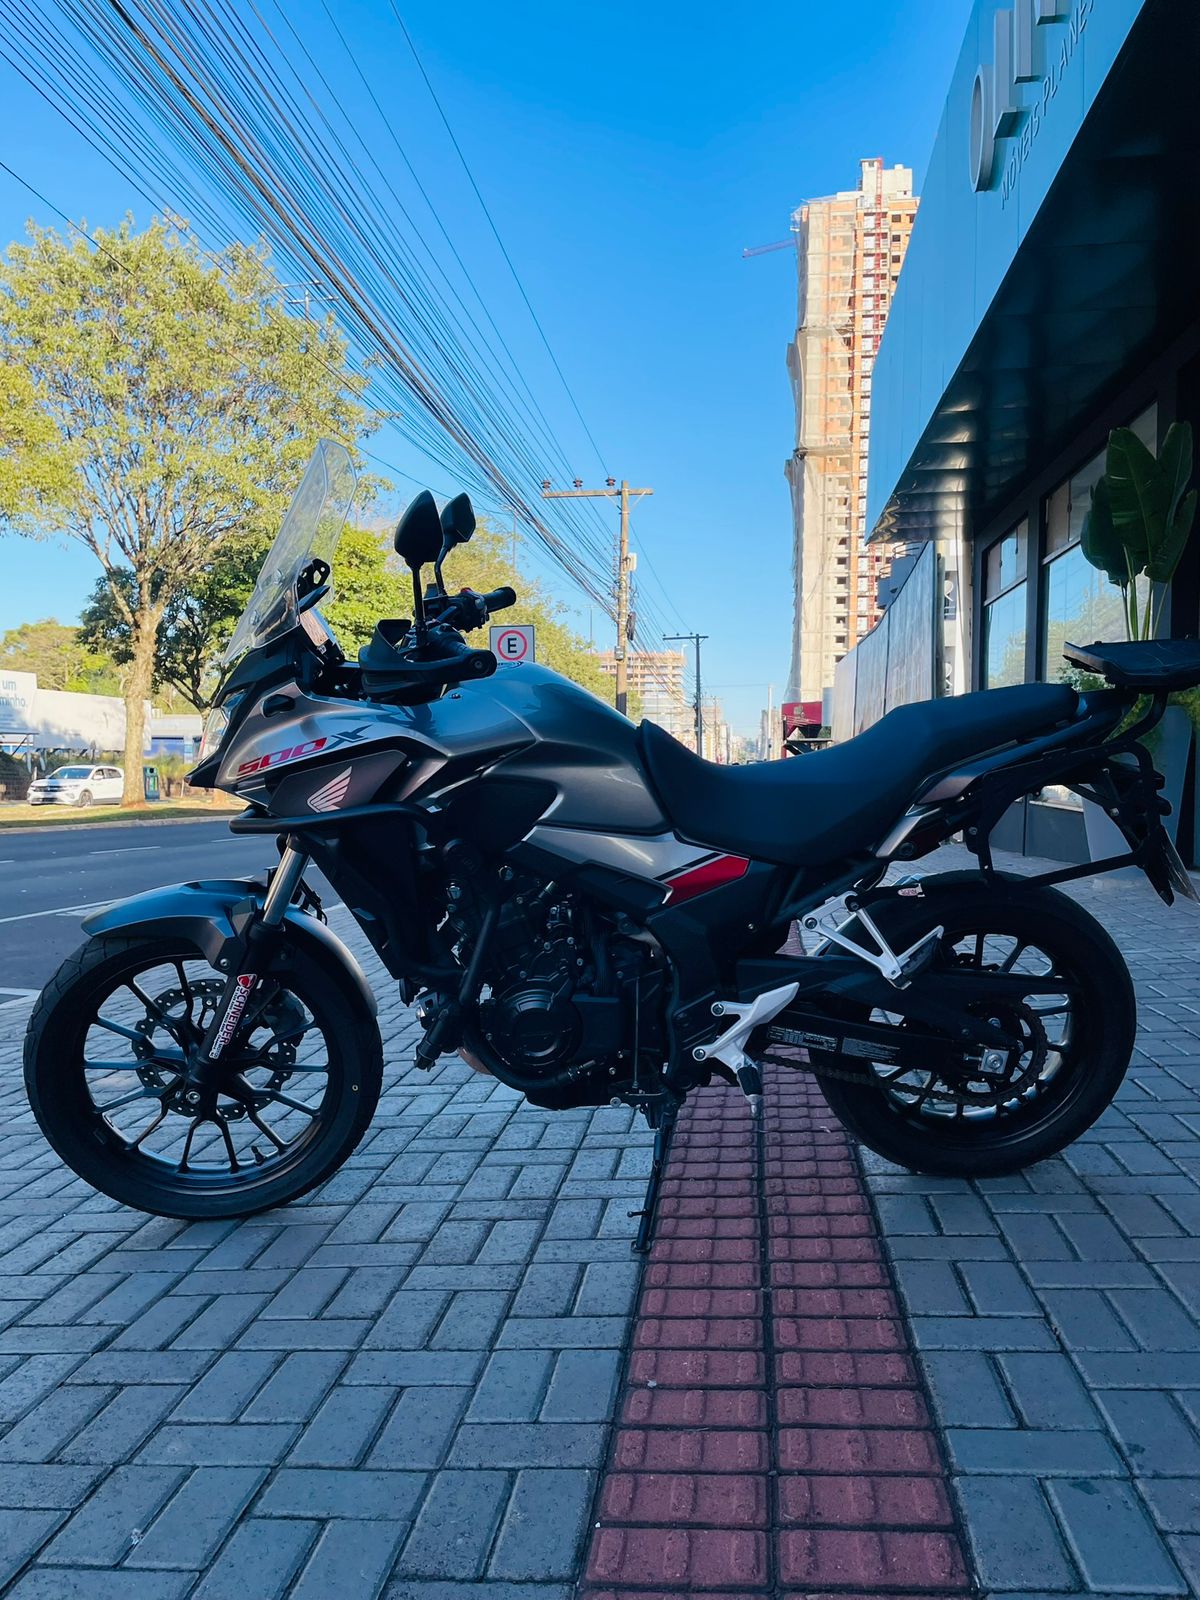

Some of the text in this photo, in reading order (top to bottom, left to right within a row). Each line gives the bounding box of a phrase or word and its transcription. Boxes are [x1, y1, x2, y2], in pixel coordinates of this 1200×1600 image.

[1001, 100, 1040, 211] MÓVEIS
[507, 637, 517, 654] E
[2, 680, 17, 691] um
[238, 724, 372, 775] 500X
[220, 986, 251, 1045] SCHNEIDER
